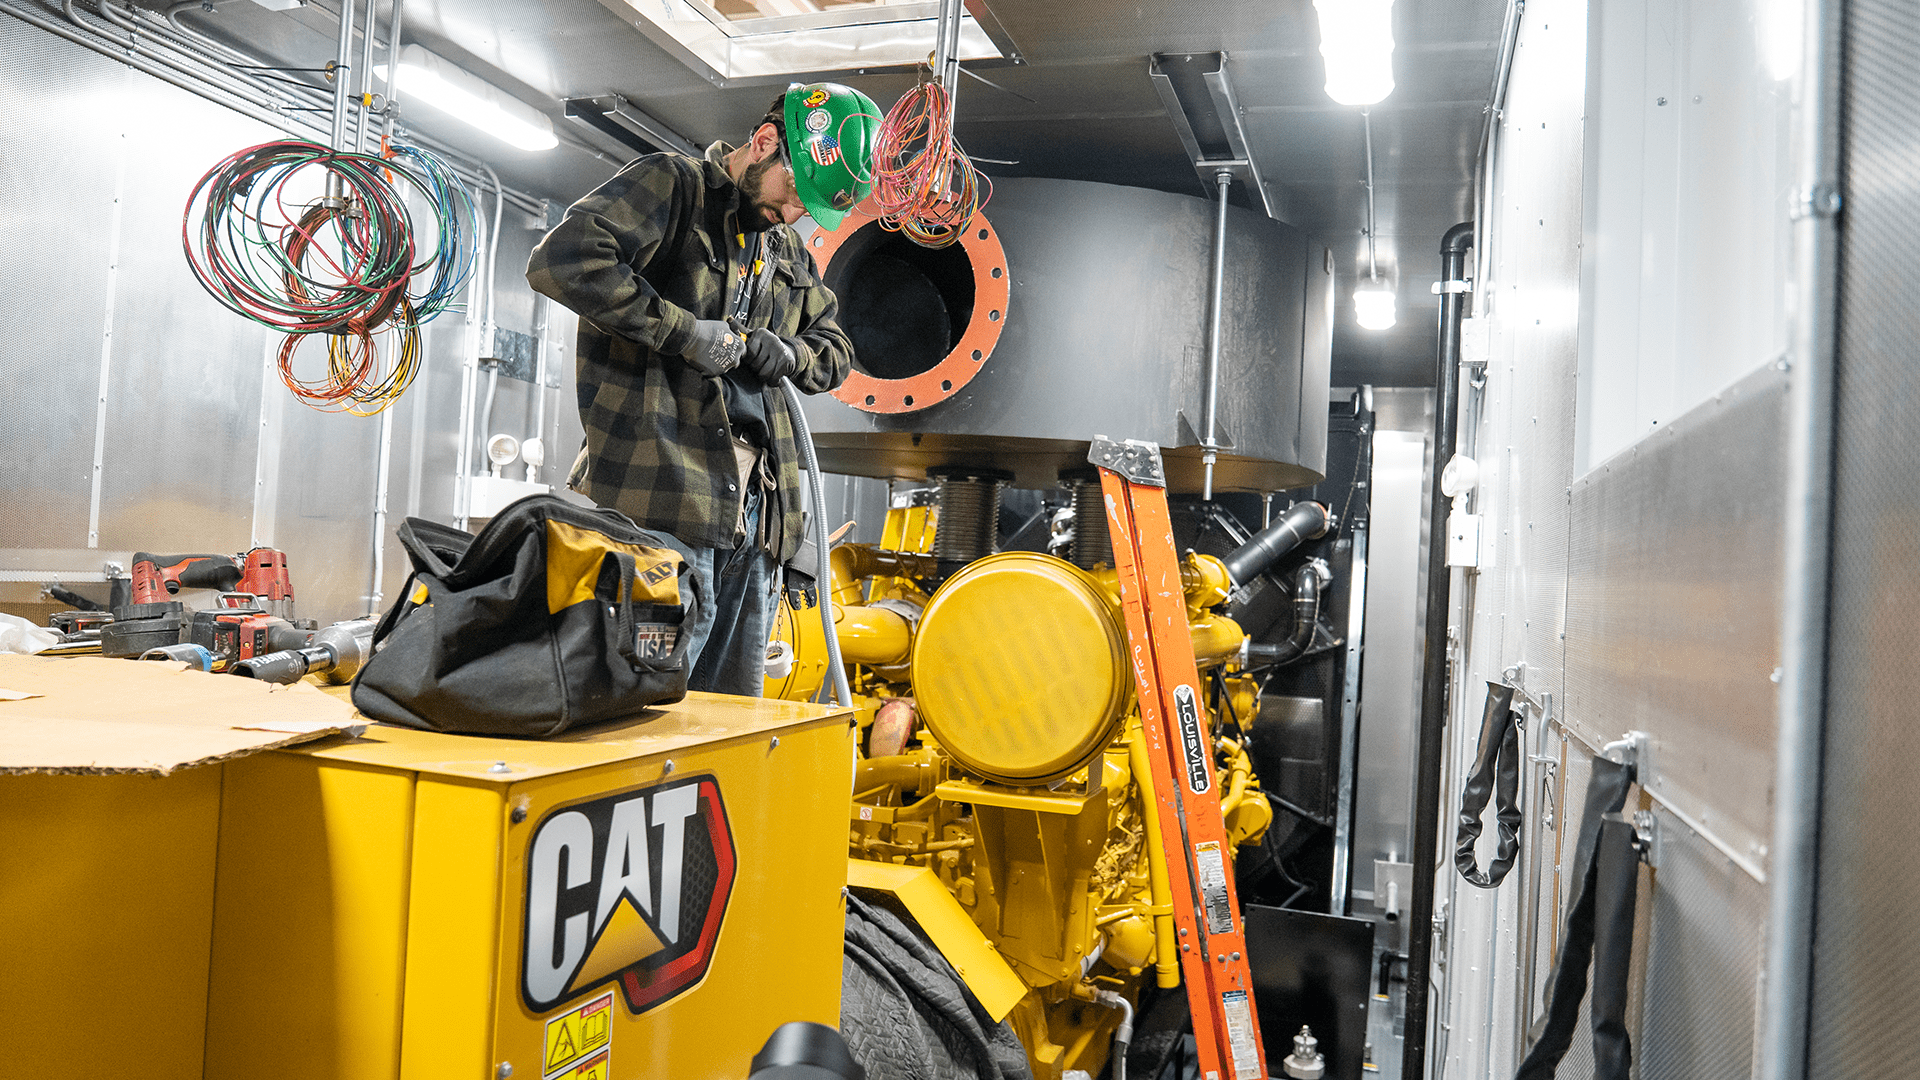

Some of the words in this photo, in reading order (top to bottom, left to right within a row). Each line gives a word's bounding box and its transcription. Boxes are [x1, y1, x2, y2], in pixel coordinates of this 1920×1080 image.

[645, 561, 672, 584] ALT
[638, 640, 667, 659] USA
[1182, 704, 1205, 791] LOUISVILLE
[527, 783, 698, 1003] CAT
